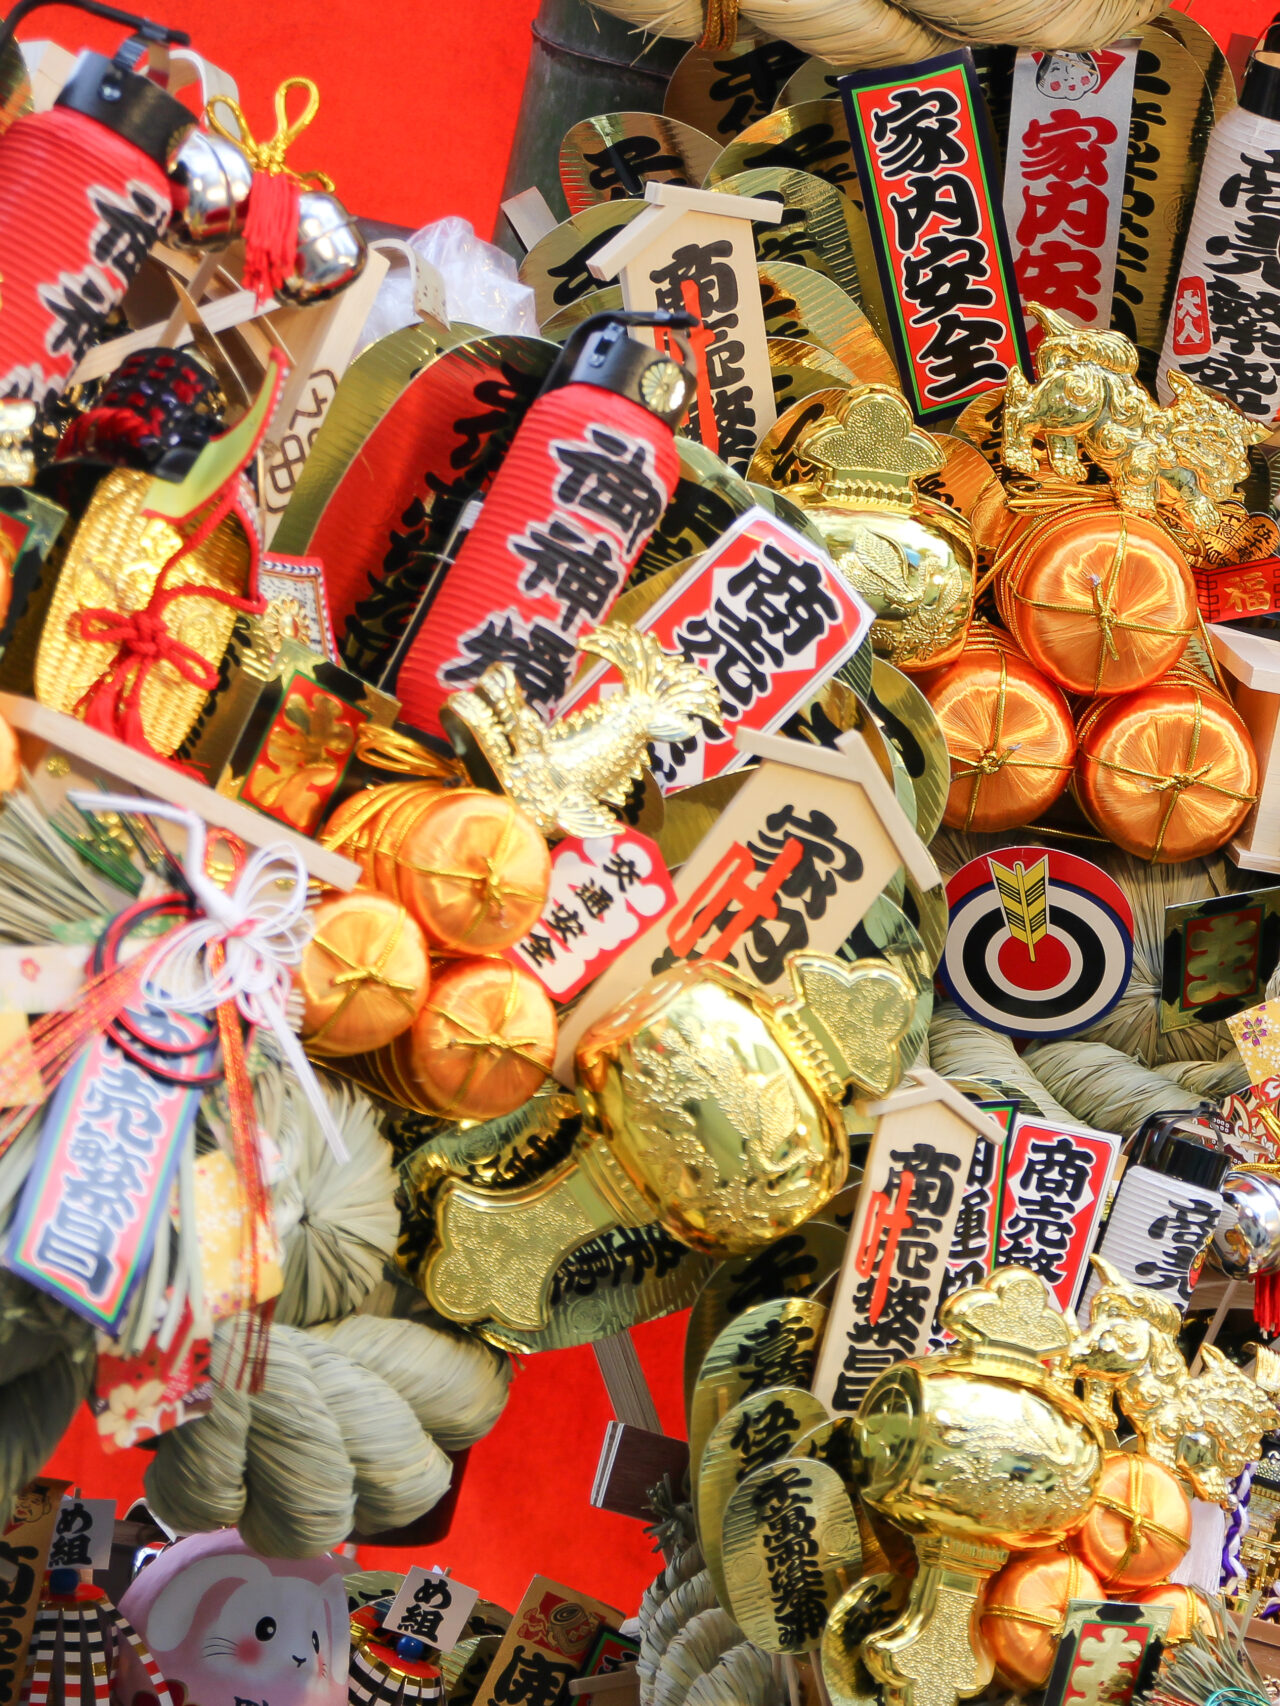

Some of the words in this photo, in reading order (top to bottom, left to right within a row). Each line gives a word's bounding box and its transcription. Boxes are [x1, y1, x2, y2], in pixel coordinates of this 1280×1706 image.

[873, 89, 1005, 399] 家内安全
[1014, 109, 1118, 352] 家内安
[1176, 288, 1206, 346] 大入
[1223, 571, 1272, 613] 福
[519, 852, 641, 969] 交通安全
[651, 803, 864, 985] 家内
[831, 1143, 961, 1412] 商売繁昌
[997, 1138, 1094, 1285] 商売繁
[48, 1502, 93, 1568] め組
[396, 1577, 452, 1644] め組
